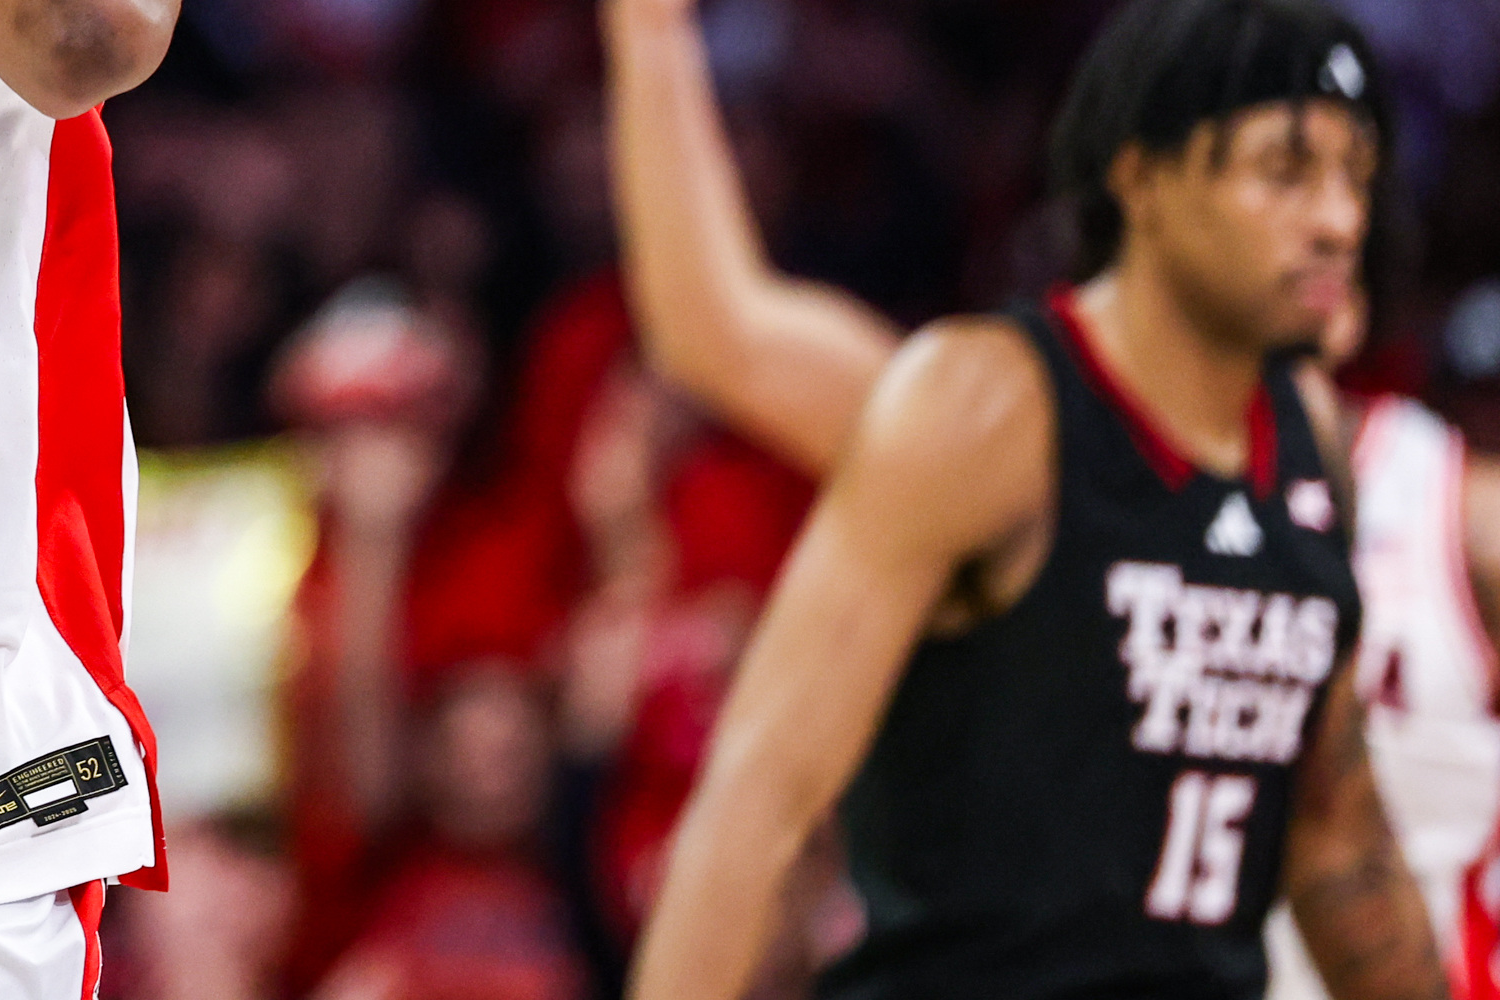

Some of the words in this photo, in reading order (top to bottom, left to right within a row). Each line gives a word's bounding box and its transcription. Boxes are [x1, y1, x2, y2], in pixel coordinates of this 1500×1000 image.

[12, 758, 64, 783] ENGINEERED
[76, 757, 103, 781] 52
[1144, 769, 1258, 925] 15
